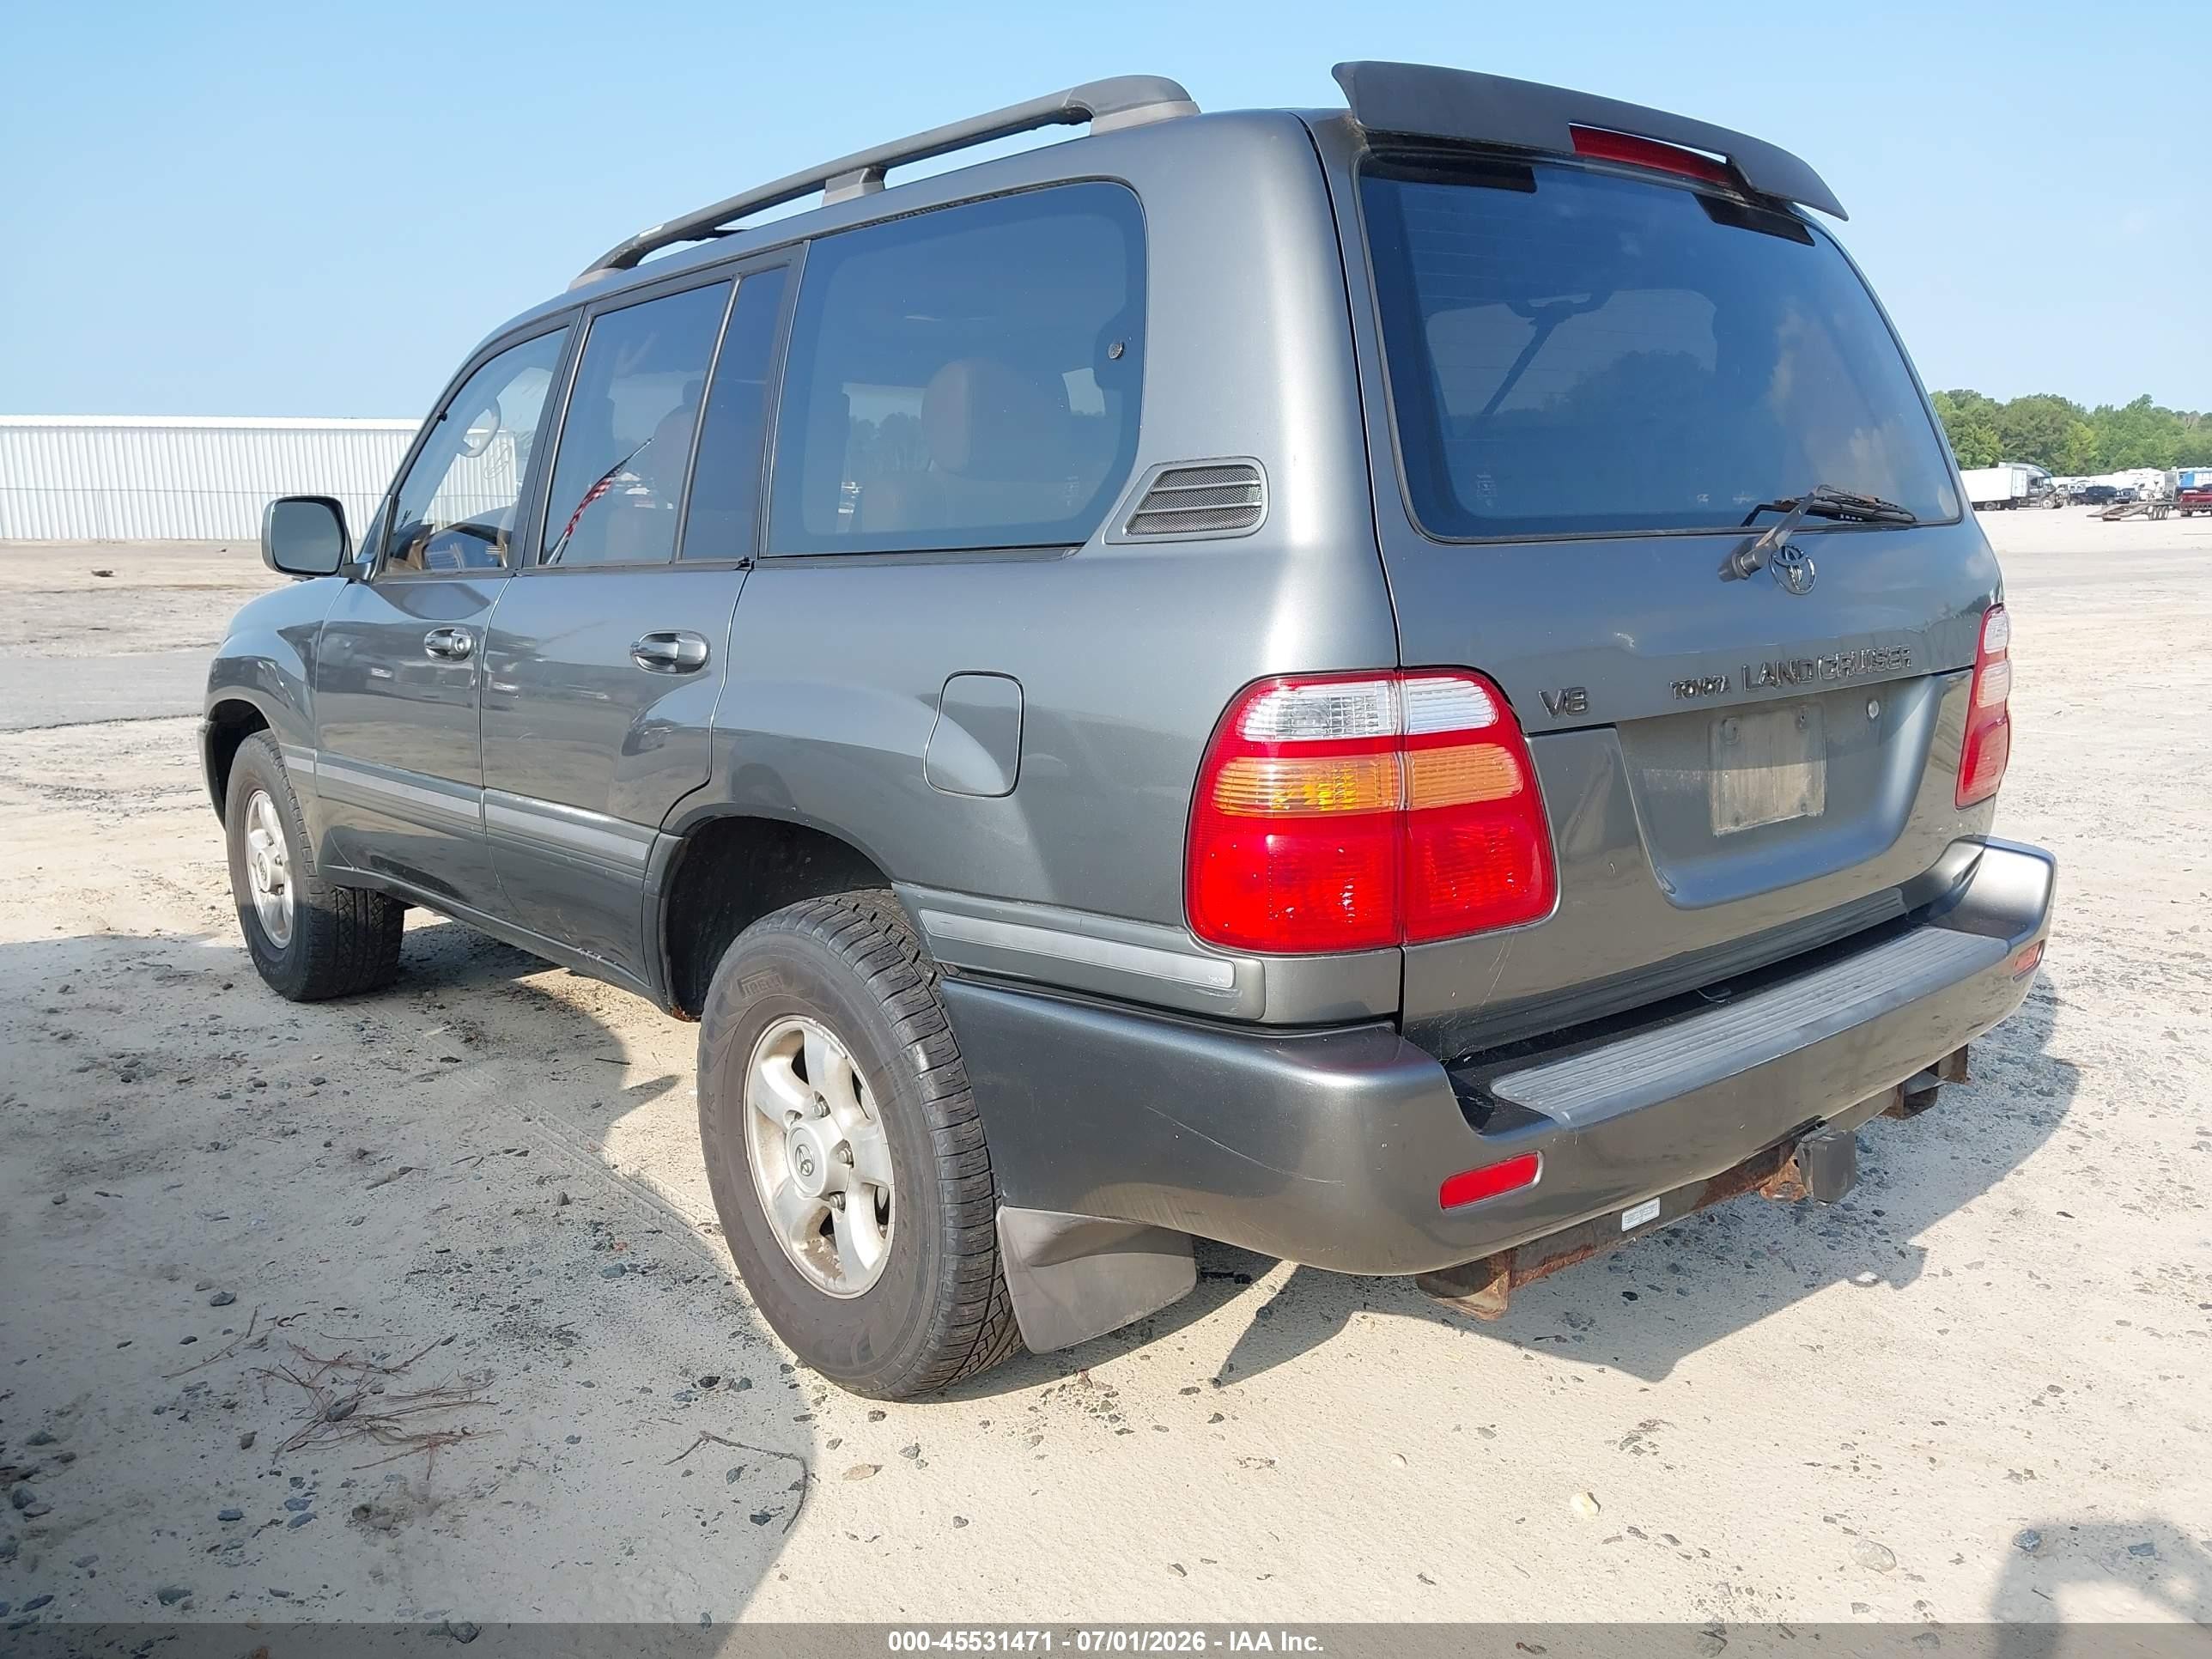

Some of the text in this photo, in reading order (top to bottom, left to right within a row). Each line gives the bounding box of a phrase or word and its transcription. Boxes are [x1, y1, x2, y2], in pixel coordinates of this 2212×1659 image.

[1741, 661, 1814, 692] LAND
[1817, 645, 1912, 680] CRUISER
[1538, 687, 1589, 718] V8
